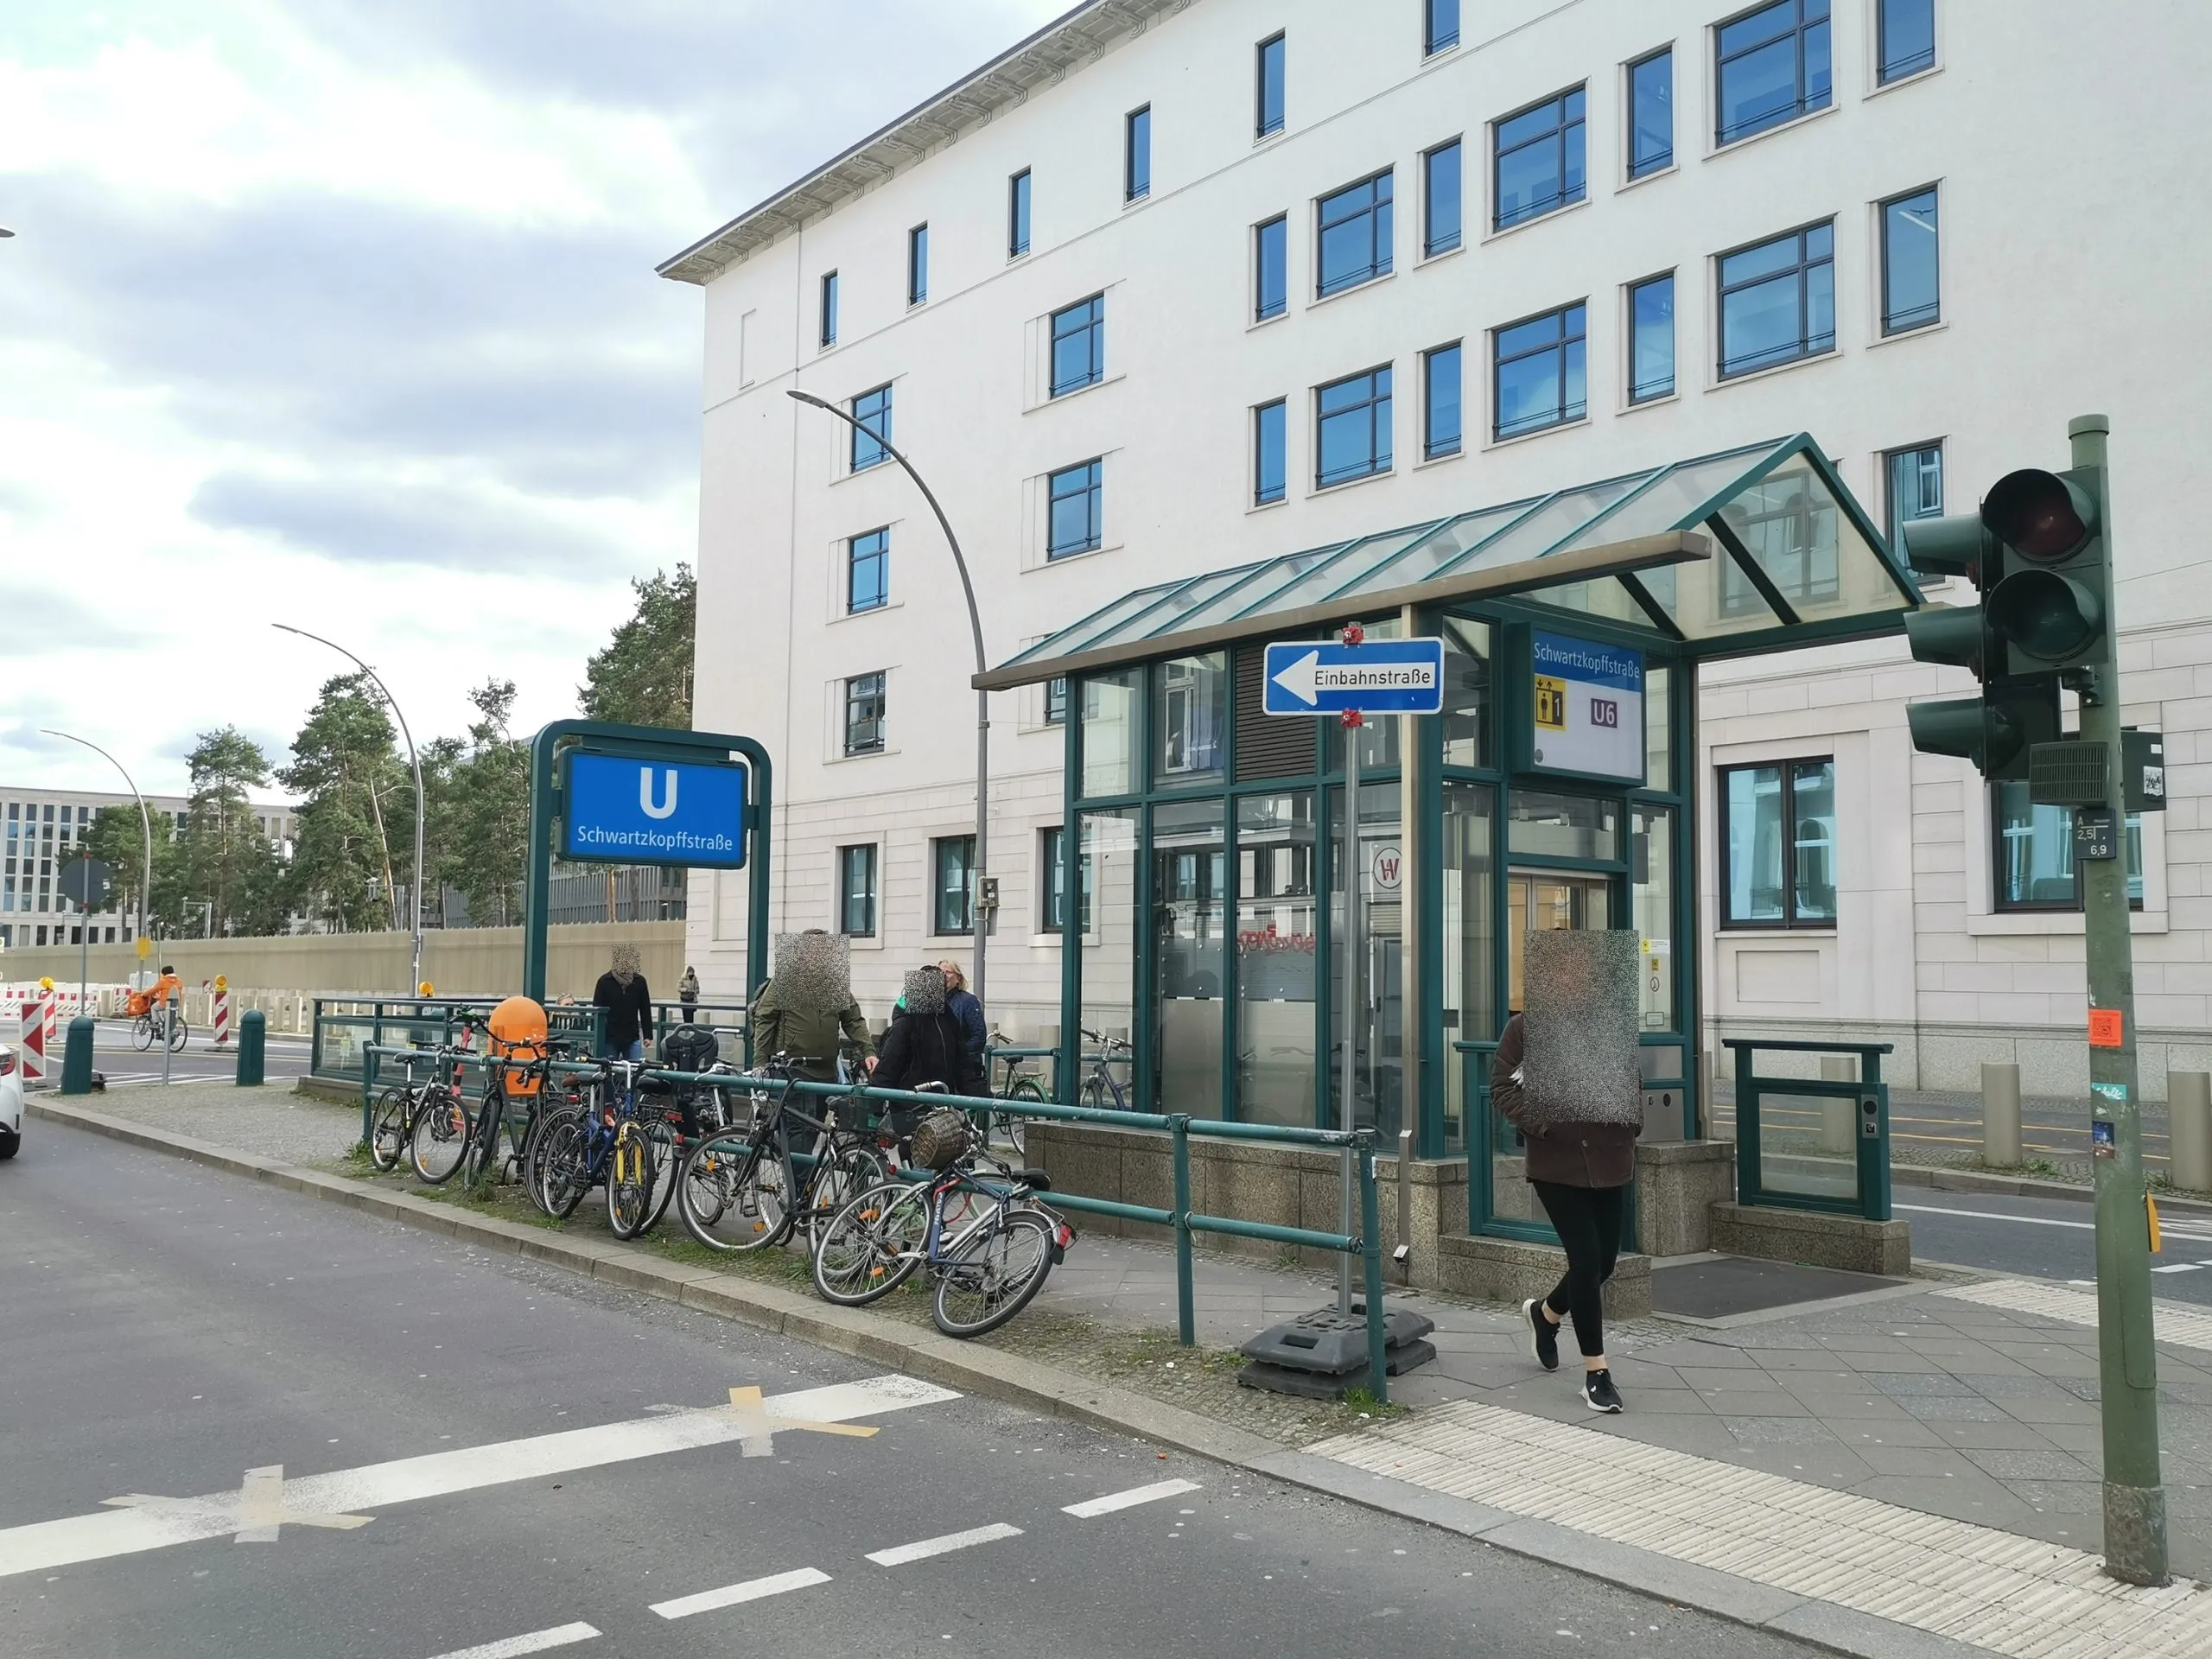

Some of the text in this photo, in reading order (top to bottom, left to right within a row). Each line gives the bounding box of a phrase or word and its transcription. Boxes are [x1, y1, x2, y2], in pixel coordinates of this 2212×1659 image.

[1534, 642, 1640, 678] Schwartzkopffstraße
[1314, 669, 1431, 685] Einbahnstraße
[1554, 697, 1560, 717] 1
[1593, 701, 1615, 725] U6
[639, 766, 678, 820] U
[577, 825, 733, 851] Schwartzkopffstraße
